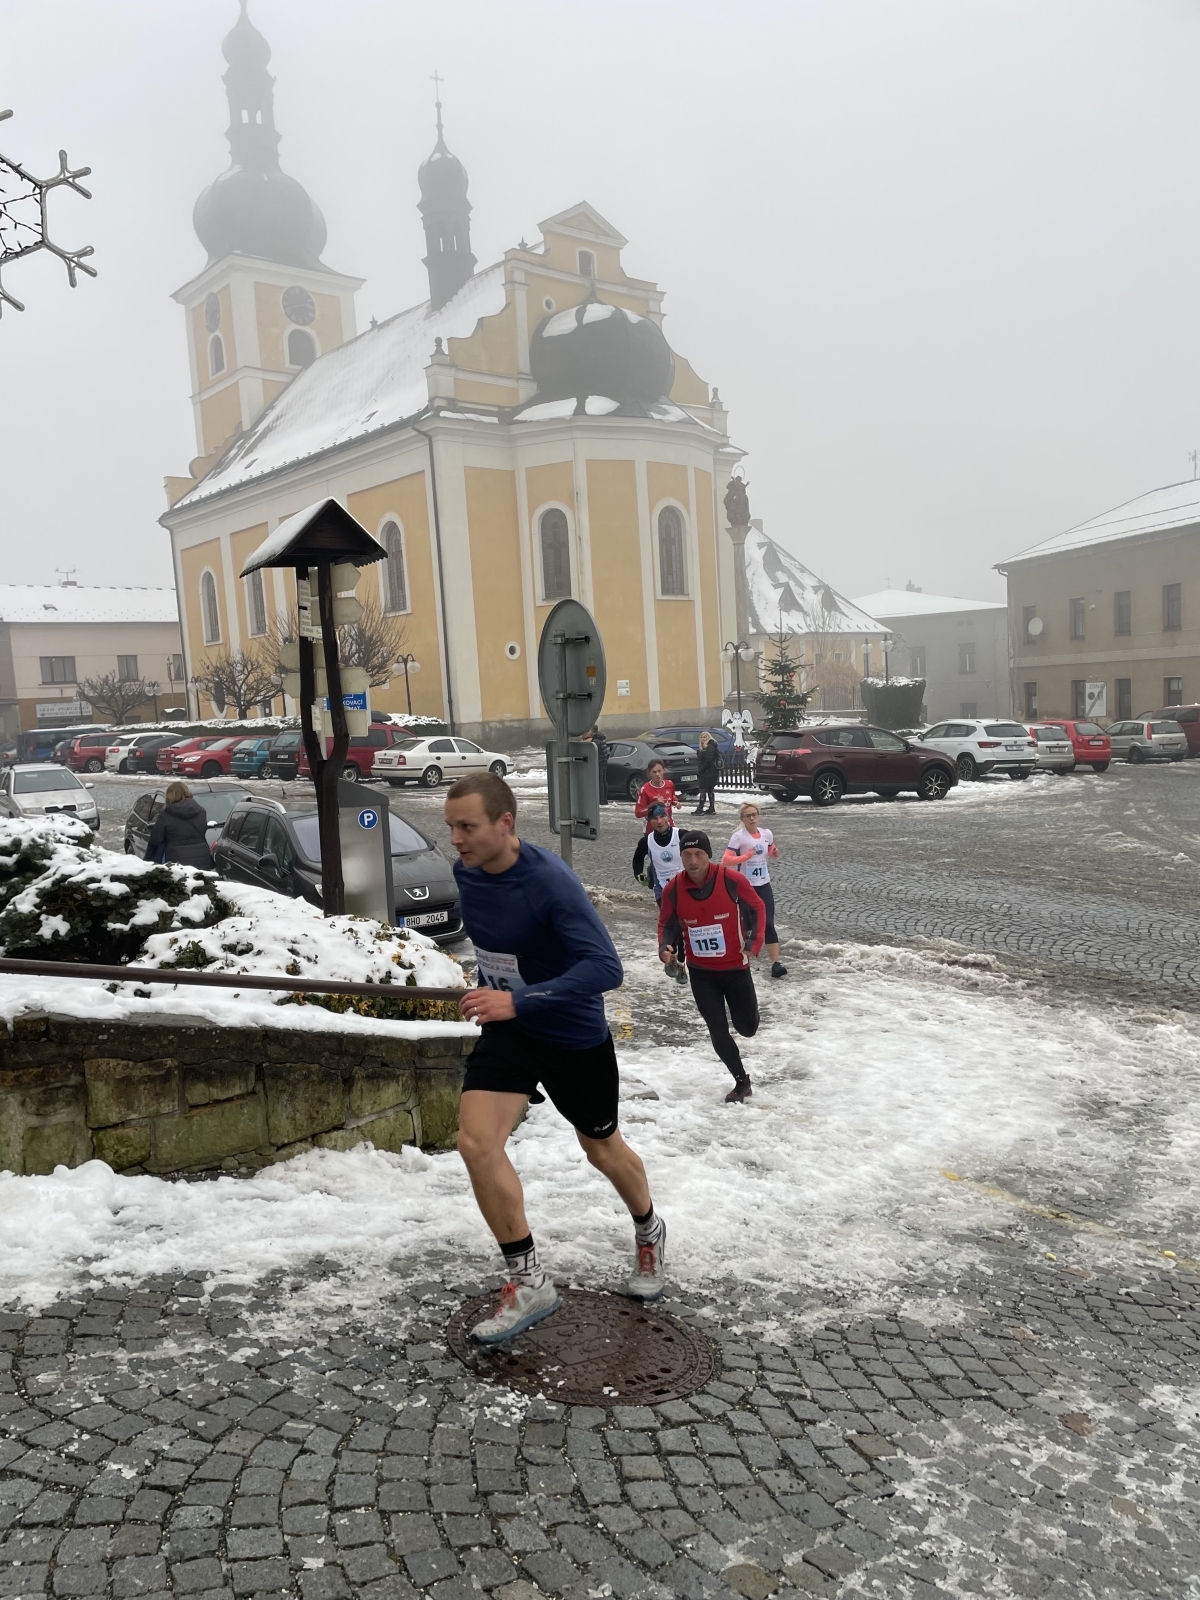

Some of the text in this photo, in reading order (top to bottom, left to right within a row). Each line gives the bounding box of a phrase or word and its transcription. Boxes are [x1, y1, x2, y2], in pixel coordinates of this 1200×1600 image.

[363, 812, 374, 826] P
[751, 867, 762, 877] 41
[426, 913, 445, 923] 2045
[695, 938, 719, 951] 115
[488, 976, 515, 991] 16
